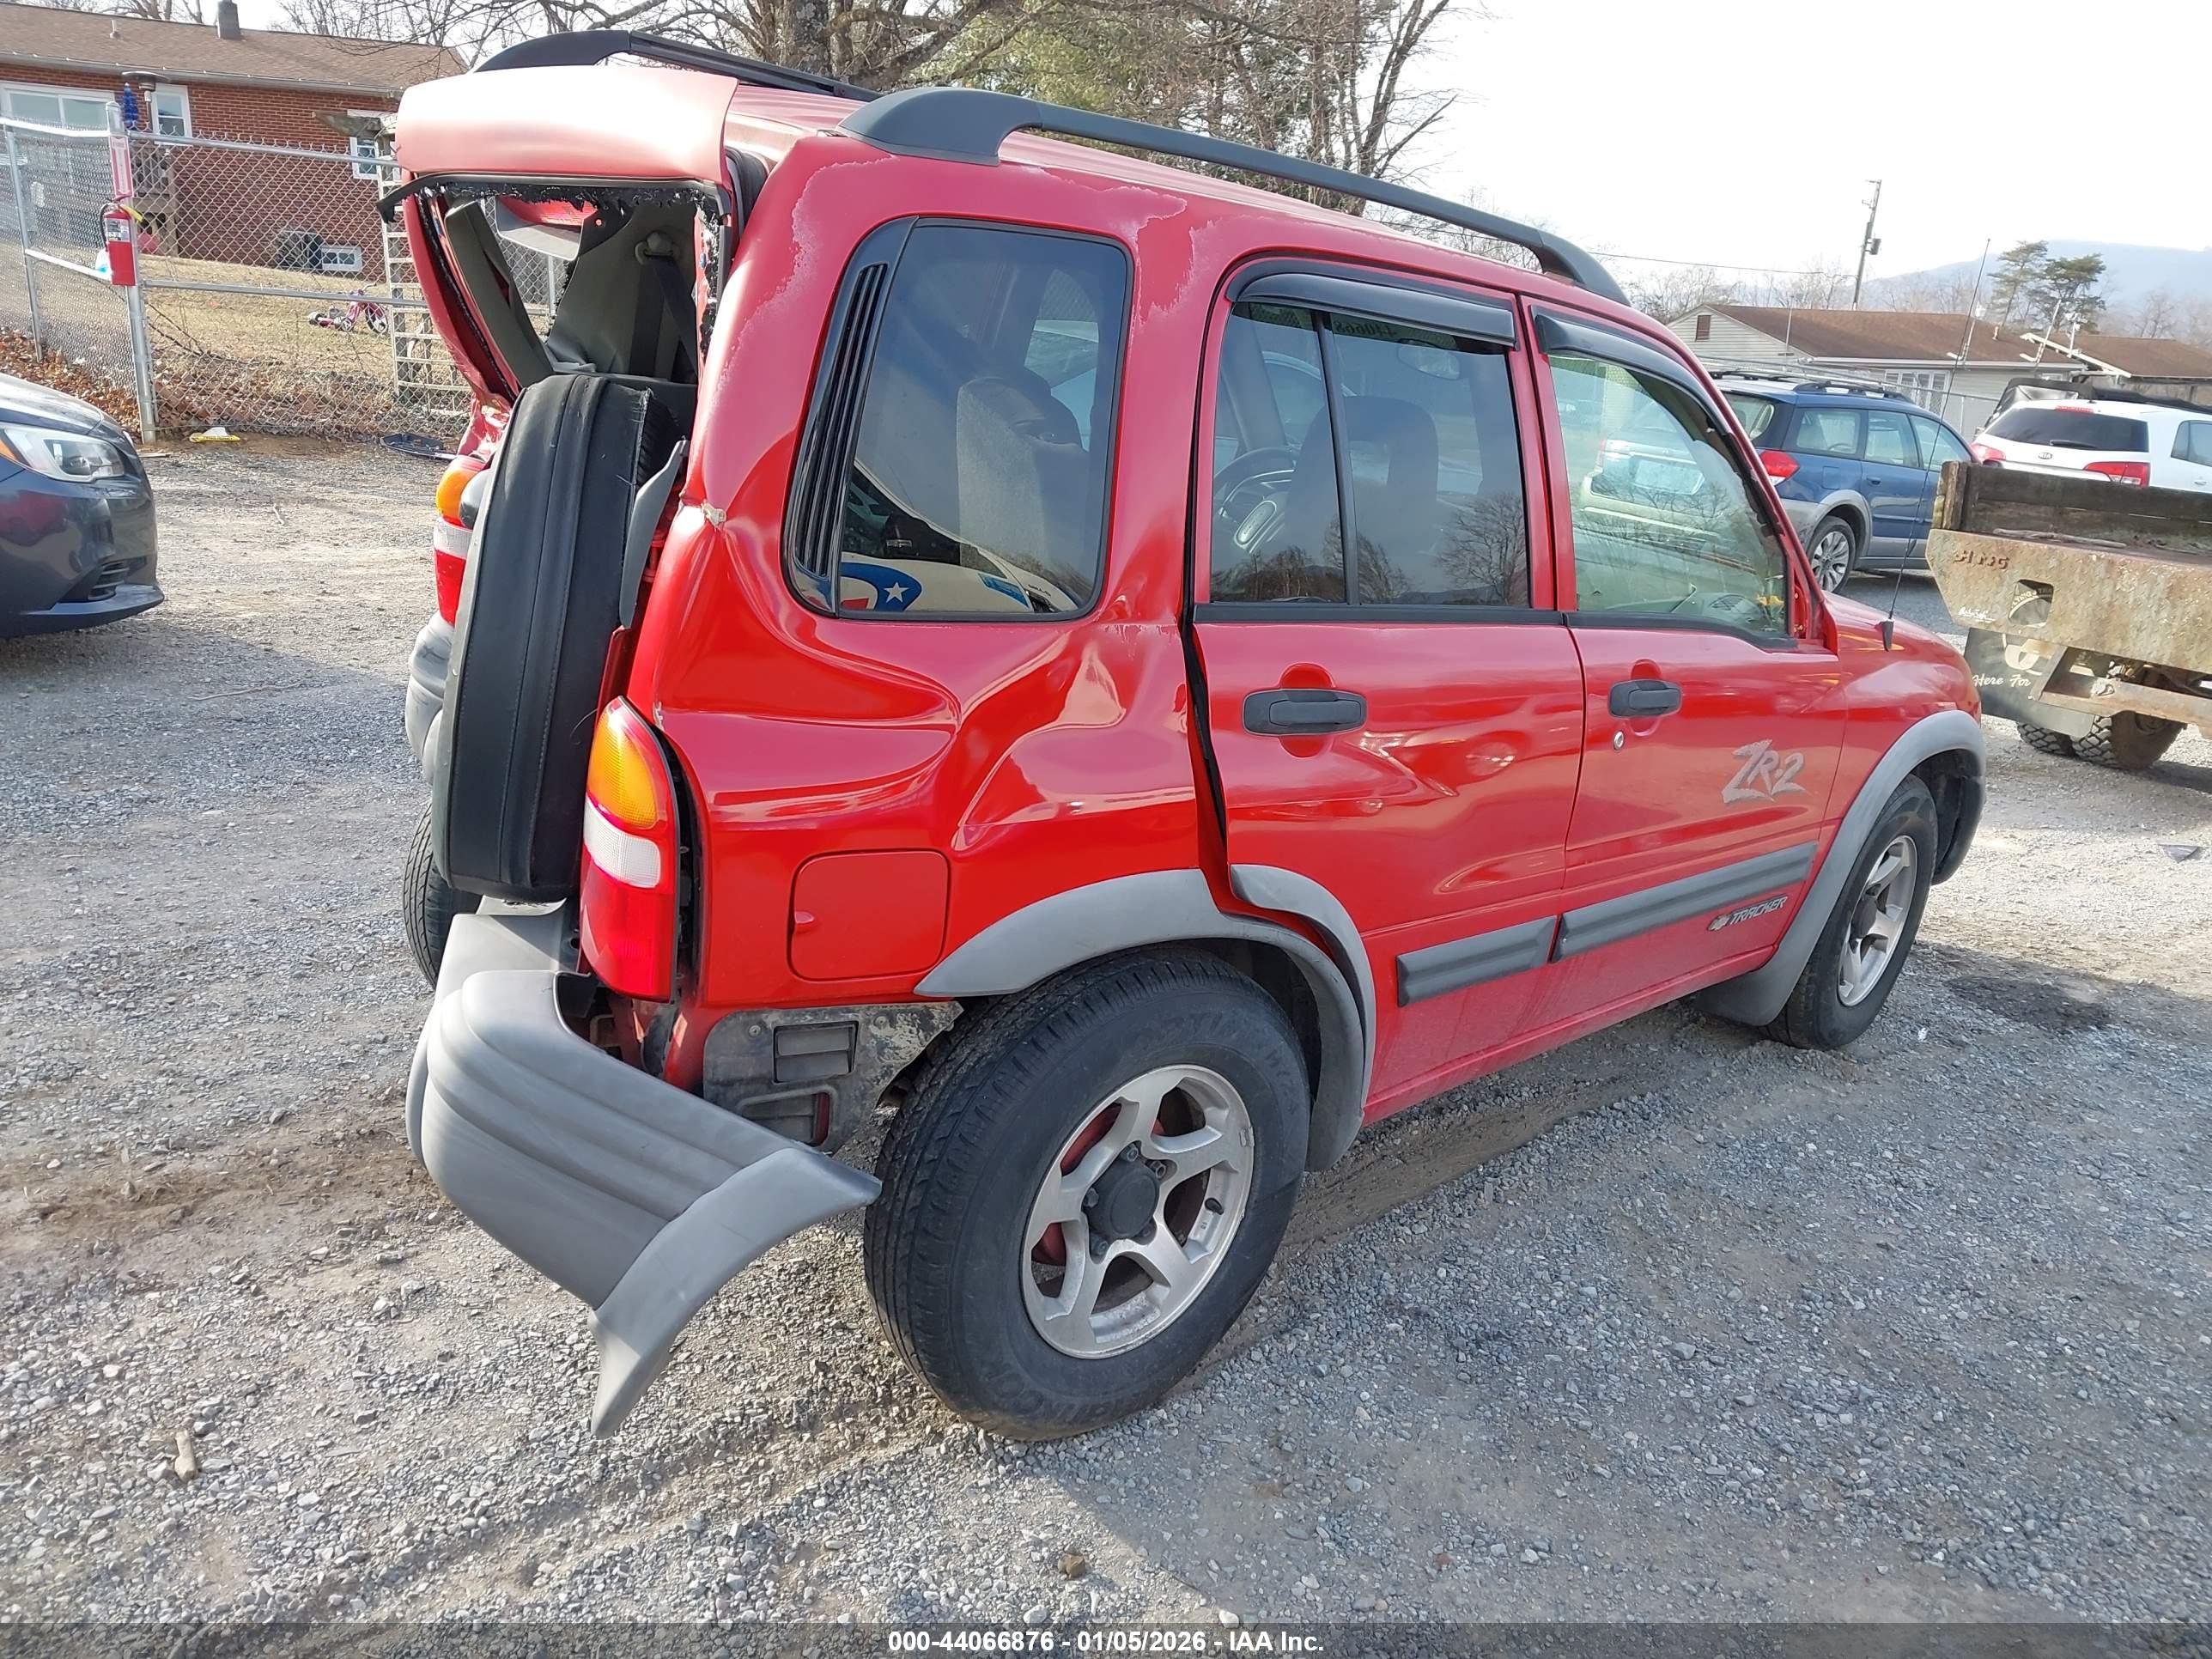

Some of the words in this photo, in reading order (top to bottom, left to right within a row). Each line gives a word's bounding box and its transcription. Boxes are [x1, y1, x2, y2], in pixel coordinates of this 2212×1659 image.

[1972, 672, 2004, 687] Here
[2009, 673, 2032, 688] For
[1729, 896, 1789, 926] TRACKER
